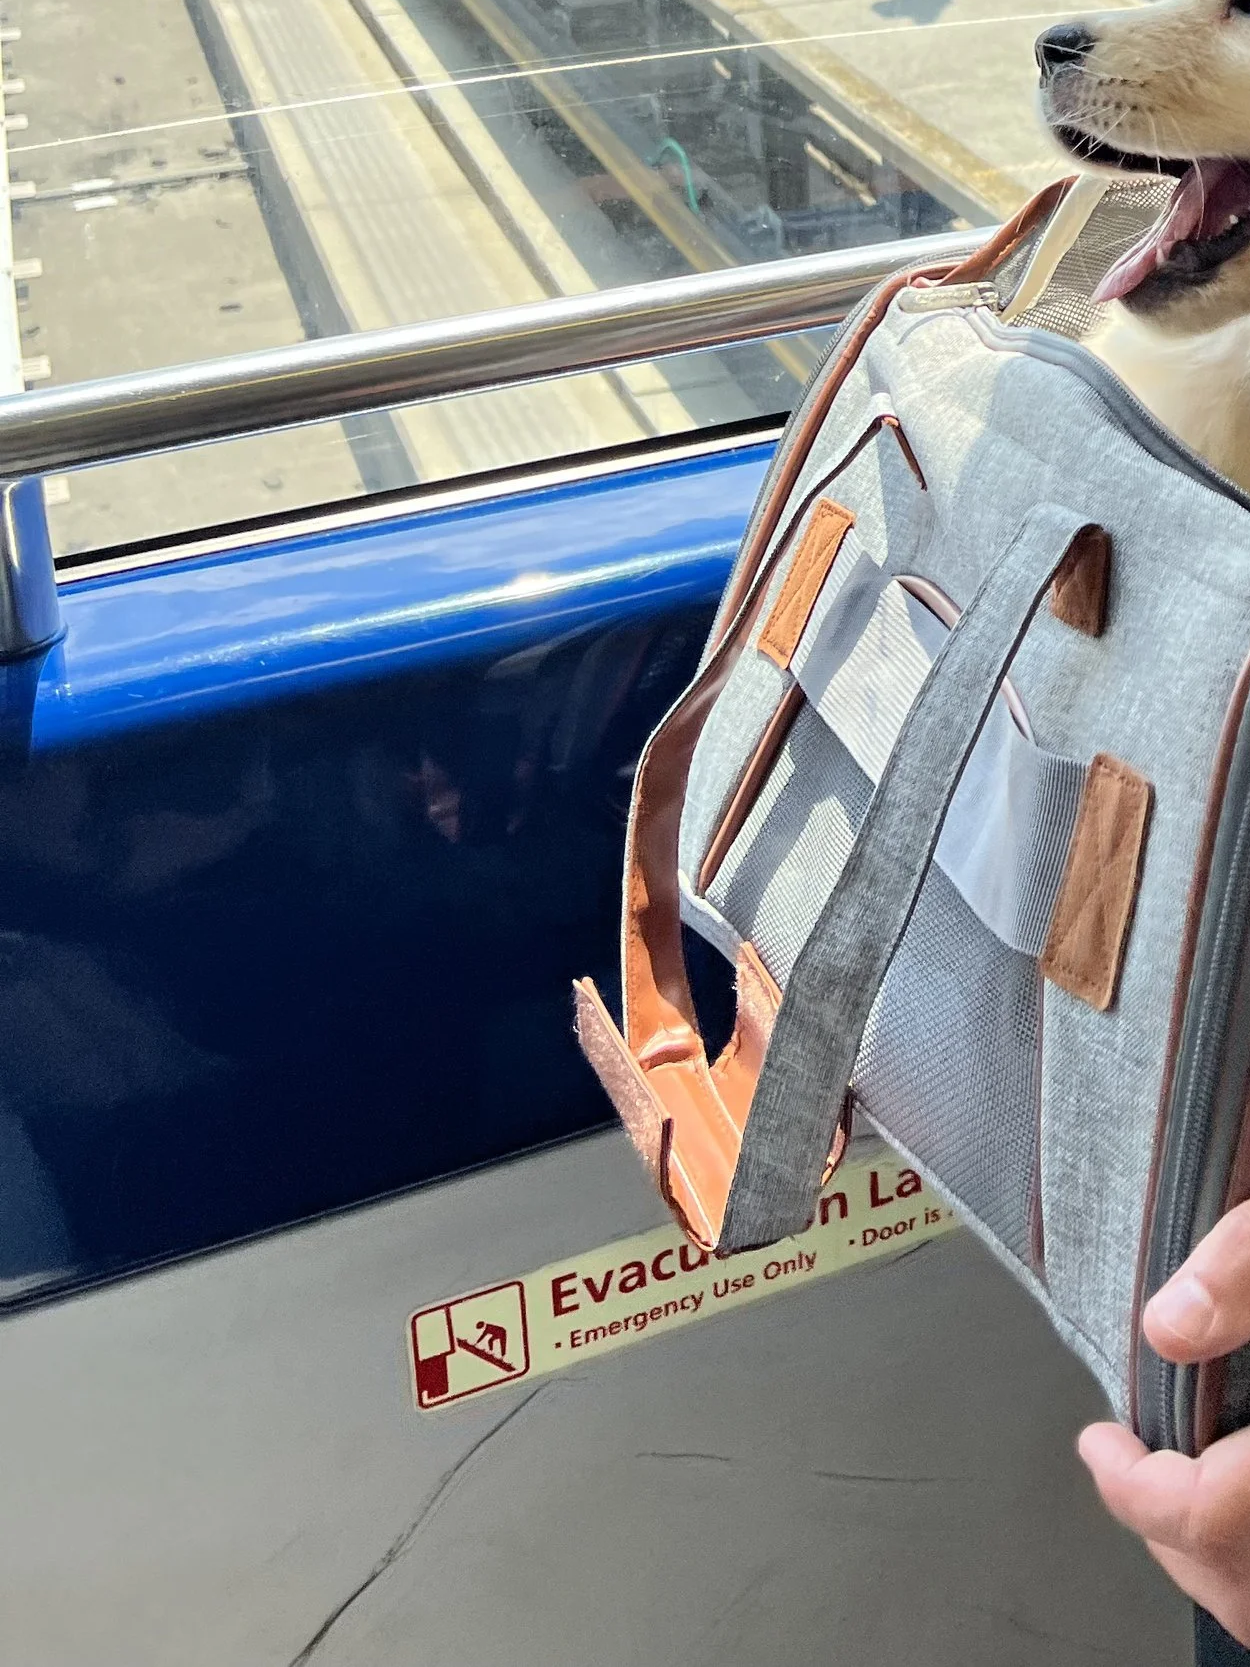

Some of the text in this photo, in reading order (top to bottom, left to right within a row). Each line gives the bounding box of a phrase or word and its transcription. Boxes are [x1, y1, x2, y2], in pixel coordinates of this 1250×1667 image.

[551, 1192, 849, 1317] Evacun
[570, 1207, 941, 1349] Emergency Use Only Door is
